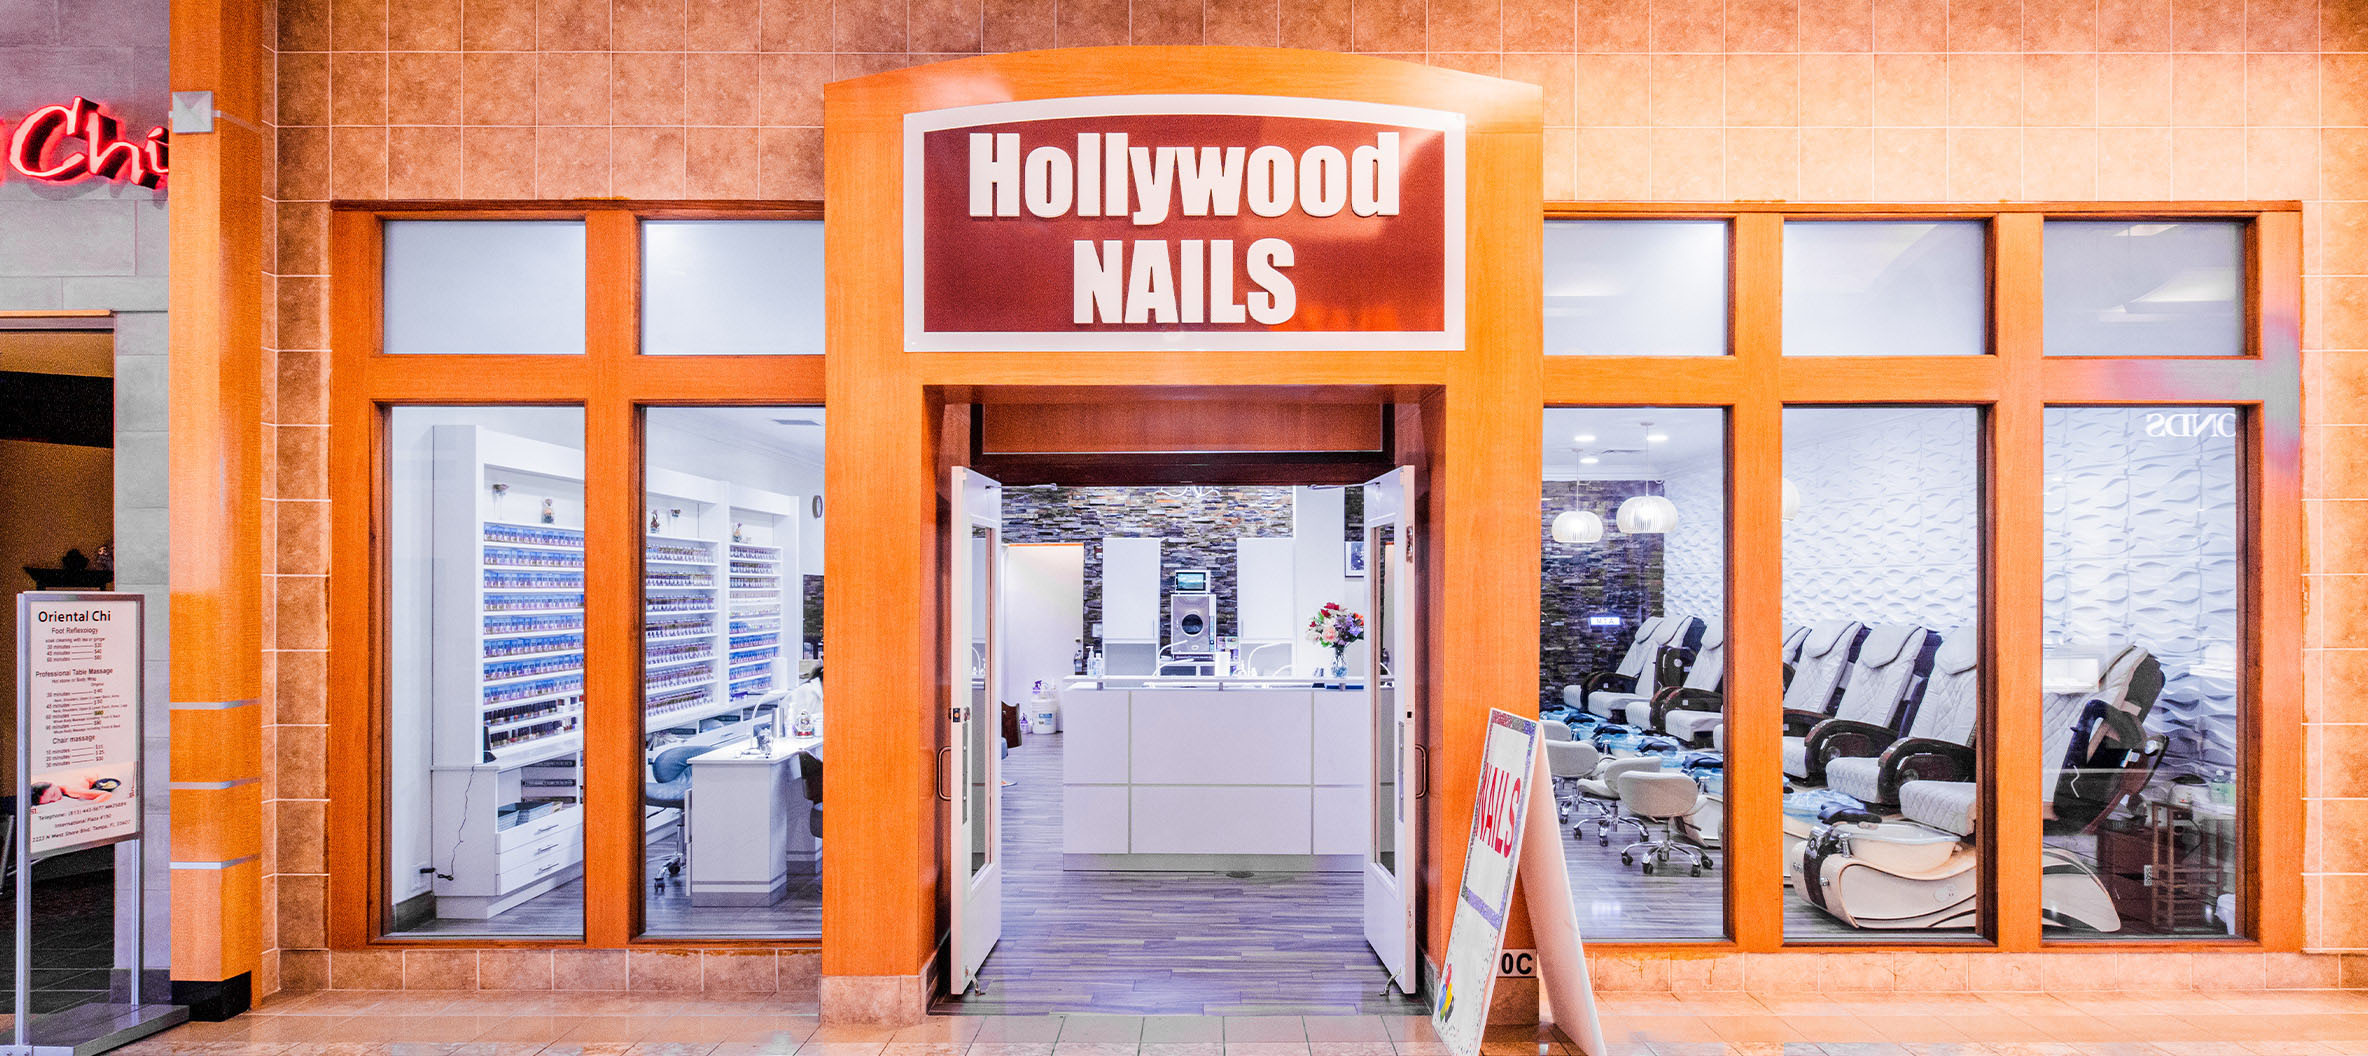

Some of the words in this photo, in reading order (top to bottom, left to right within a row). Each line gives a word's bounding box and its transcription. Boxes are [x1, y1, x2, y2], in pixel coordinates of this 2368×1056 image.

[8, 95, 169, 188] Chi
[969, 131, 1400, 226] Hollywood
[1073, 237, 1296, 325] NAILS
[38, 610, 89, 622] Oriental
[92, 610, 111, 622] Chi
[36, 670, 71, 678] Professional
[70, 735, 95, 743] massage
[55, 818, 86, 828] International
[1476, 762, 1521, 858] NAILS
